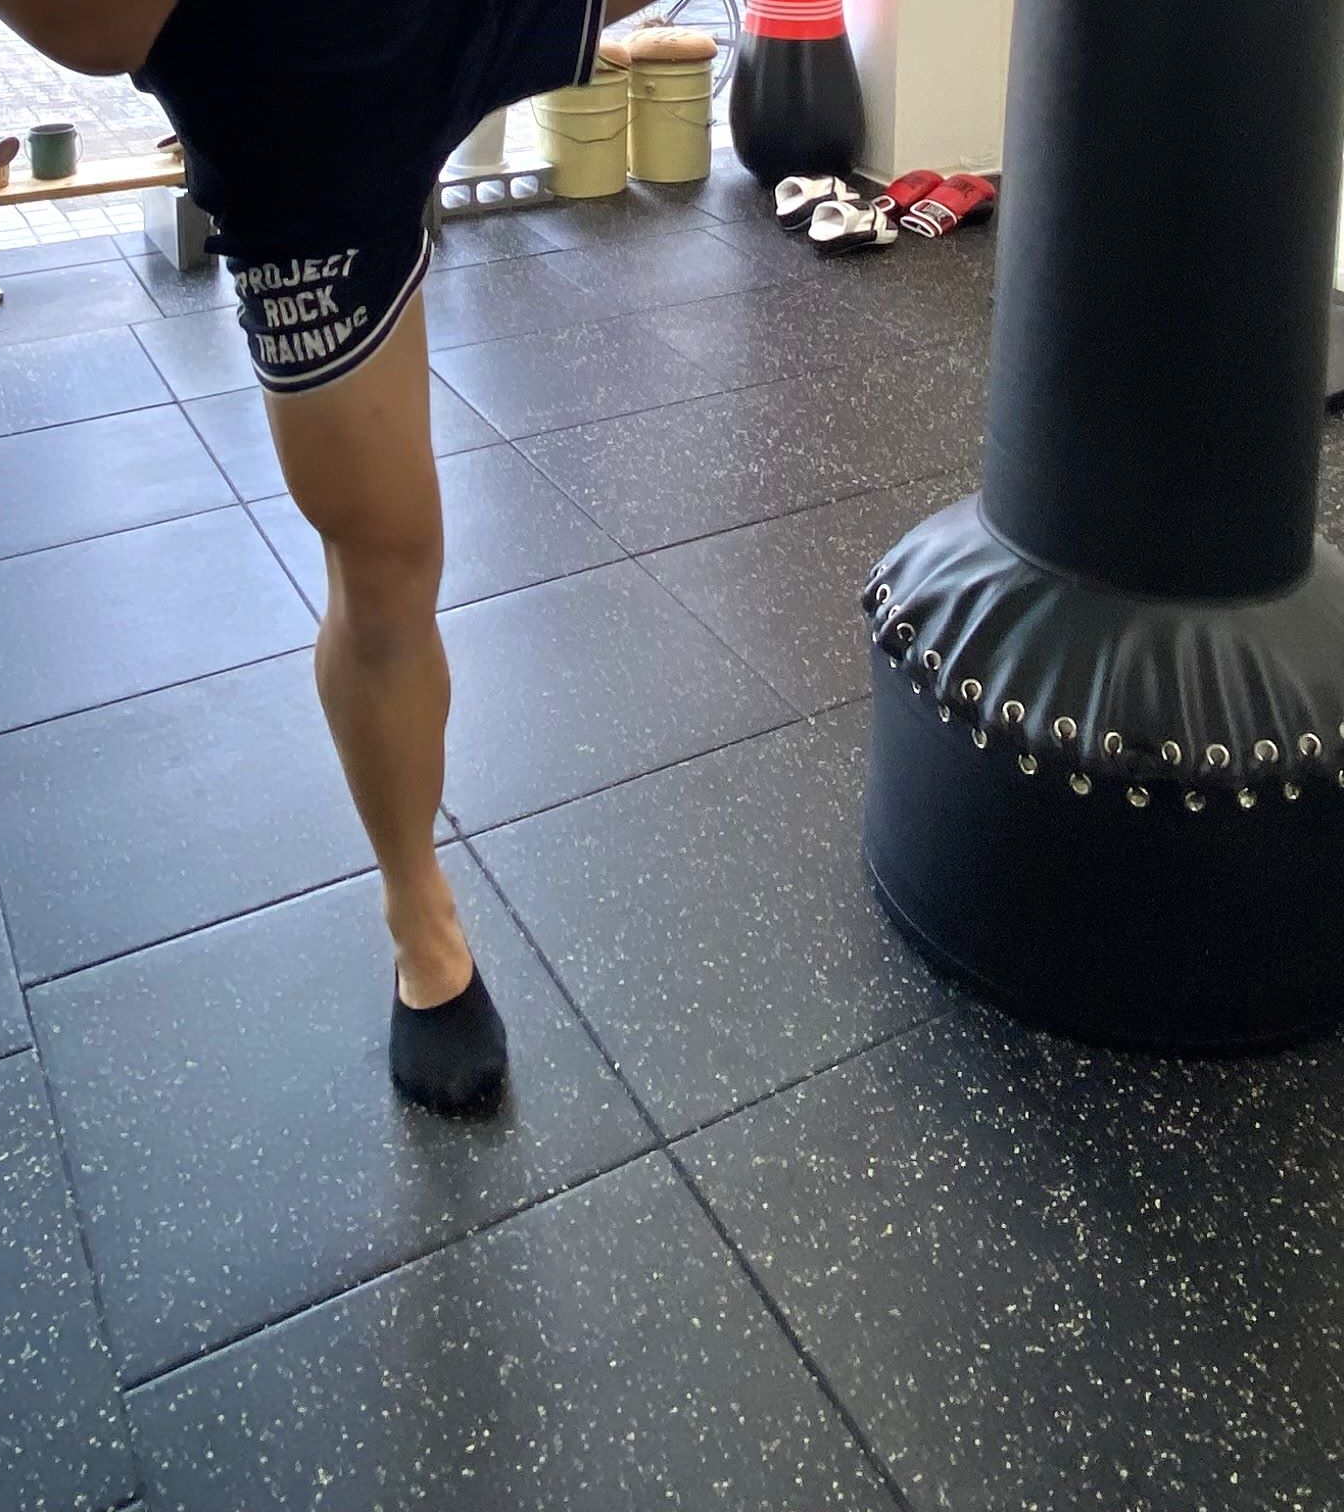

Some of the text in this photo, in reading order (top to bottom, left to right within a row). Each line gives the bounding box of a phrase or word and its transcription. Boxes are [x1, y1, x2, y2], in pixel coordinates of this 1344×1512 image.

[235, 248, 359, 297] PROJECT
[263, 285, 339, 328] ROCK
[256, 305, 368, 365] TRAINING
